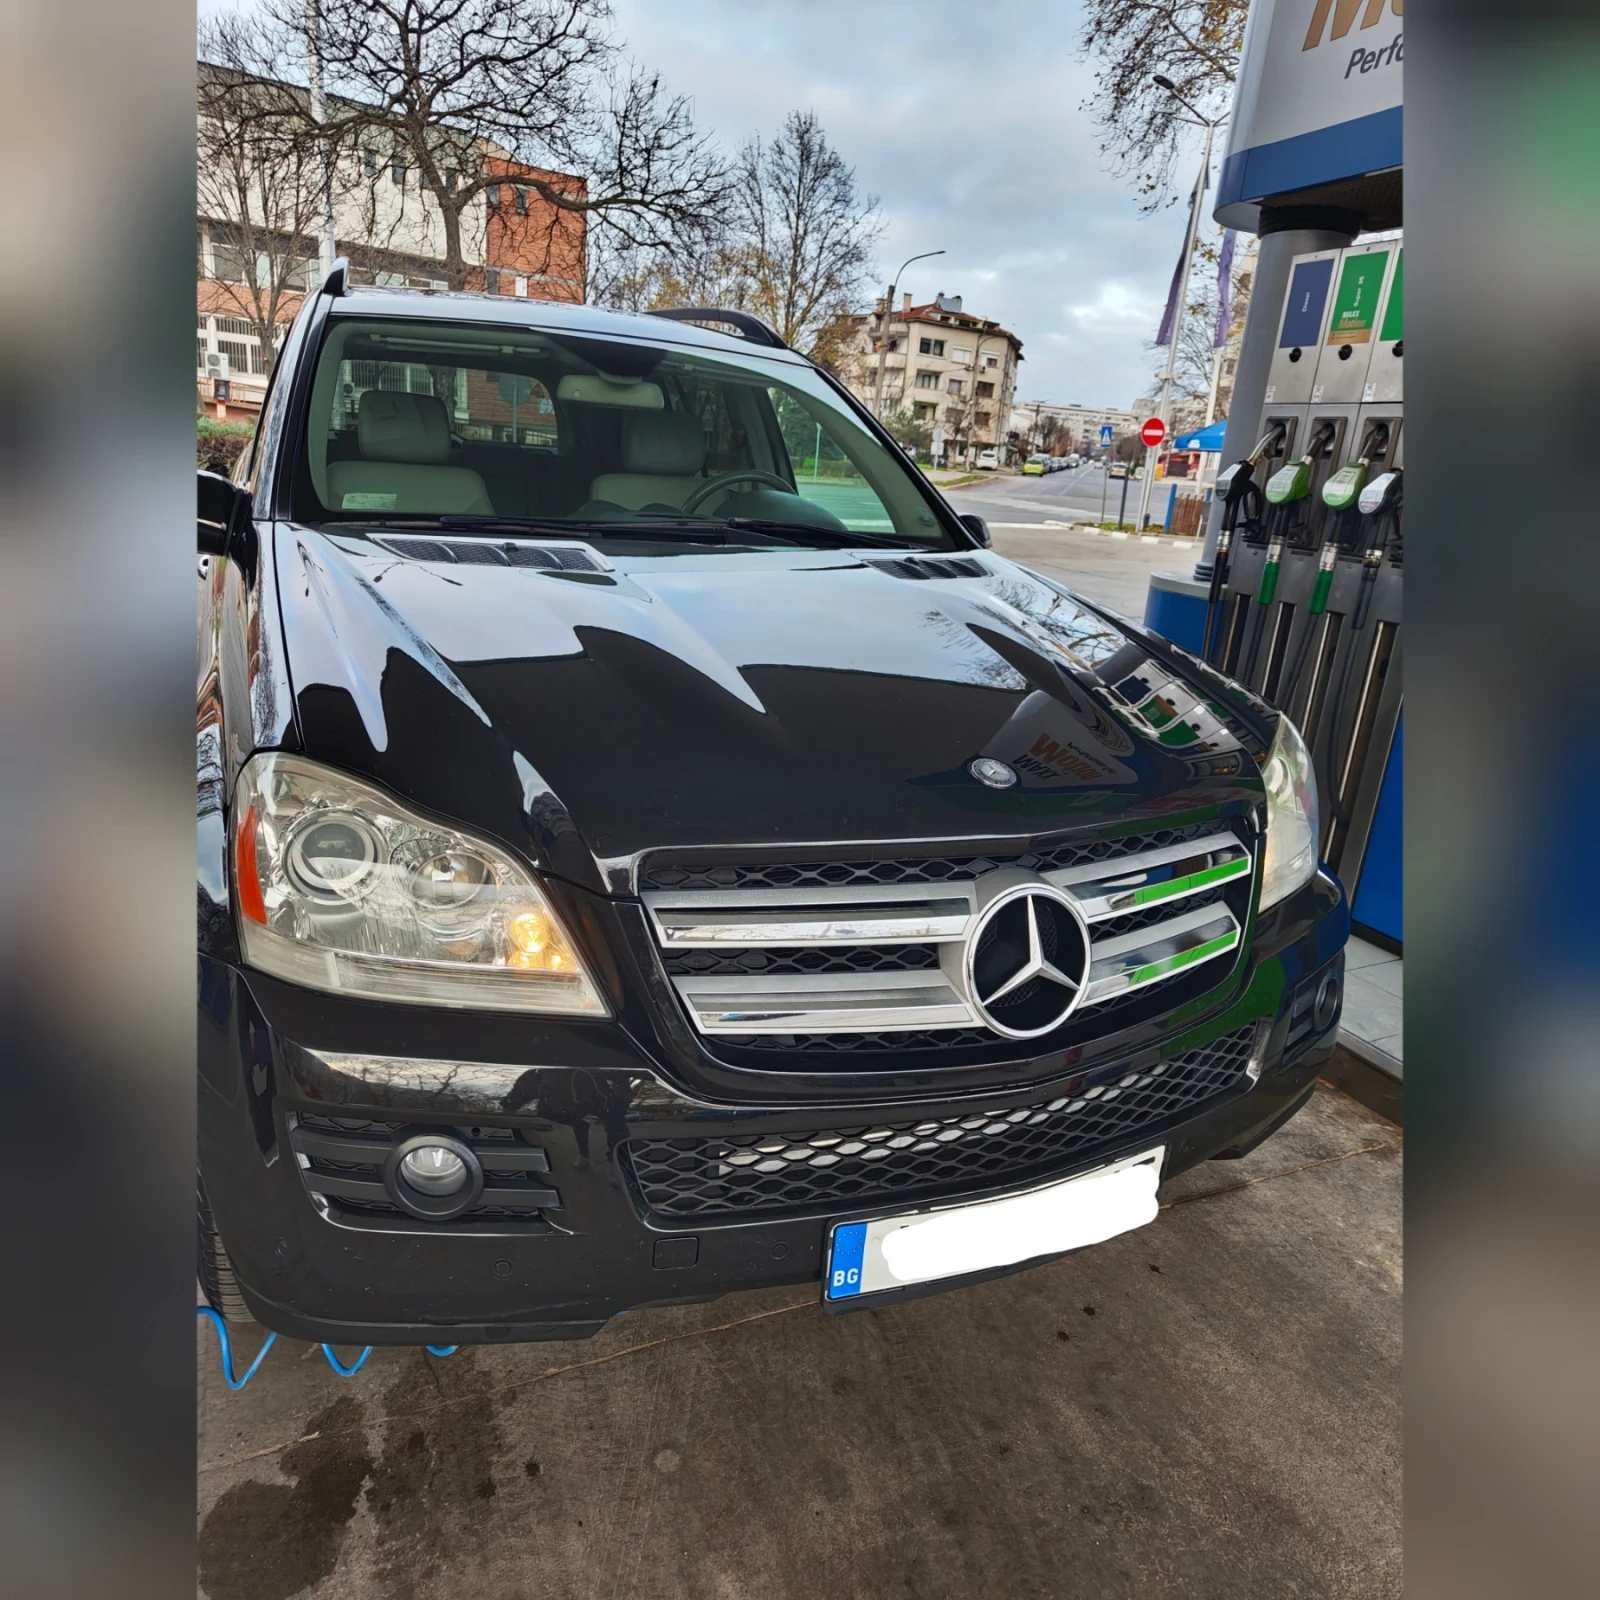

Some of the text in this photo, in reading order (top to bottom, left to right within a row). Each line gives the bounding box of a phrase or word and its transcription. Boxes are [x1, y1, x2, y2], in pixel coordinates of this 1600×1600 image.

[1301, 292, 1311, 312] Diesel
[1353, 287, 1362, 307] Super
[1338, 318, 1366, 329] Motion
[1342, 310, 1361, 319] MAXX
[833, 1268, 859, 1287] BG
